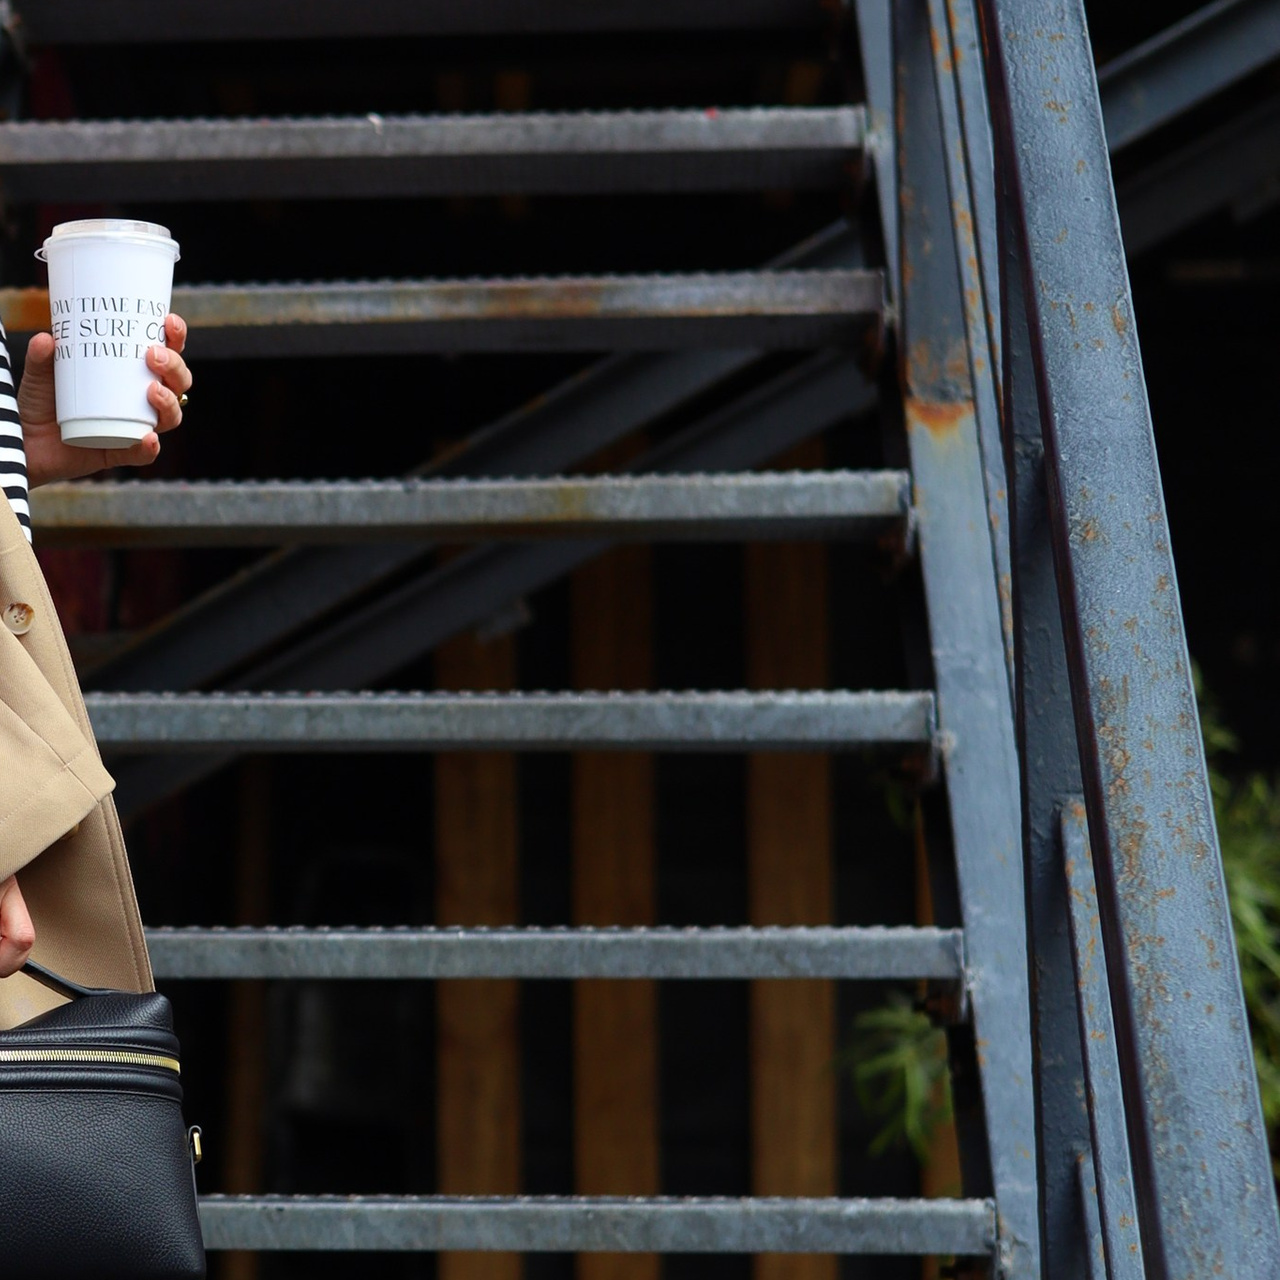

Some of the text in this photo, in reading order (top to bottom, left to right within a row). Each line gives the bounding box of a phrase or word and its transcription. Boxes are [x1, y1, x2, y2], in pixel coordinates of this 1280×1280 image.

[77, 297, 129, 314] TIME
[79, 318, 139, 337] SURF
[79, 342, 129, 358] TIME
